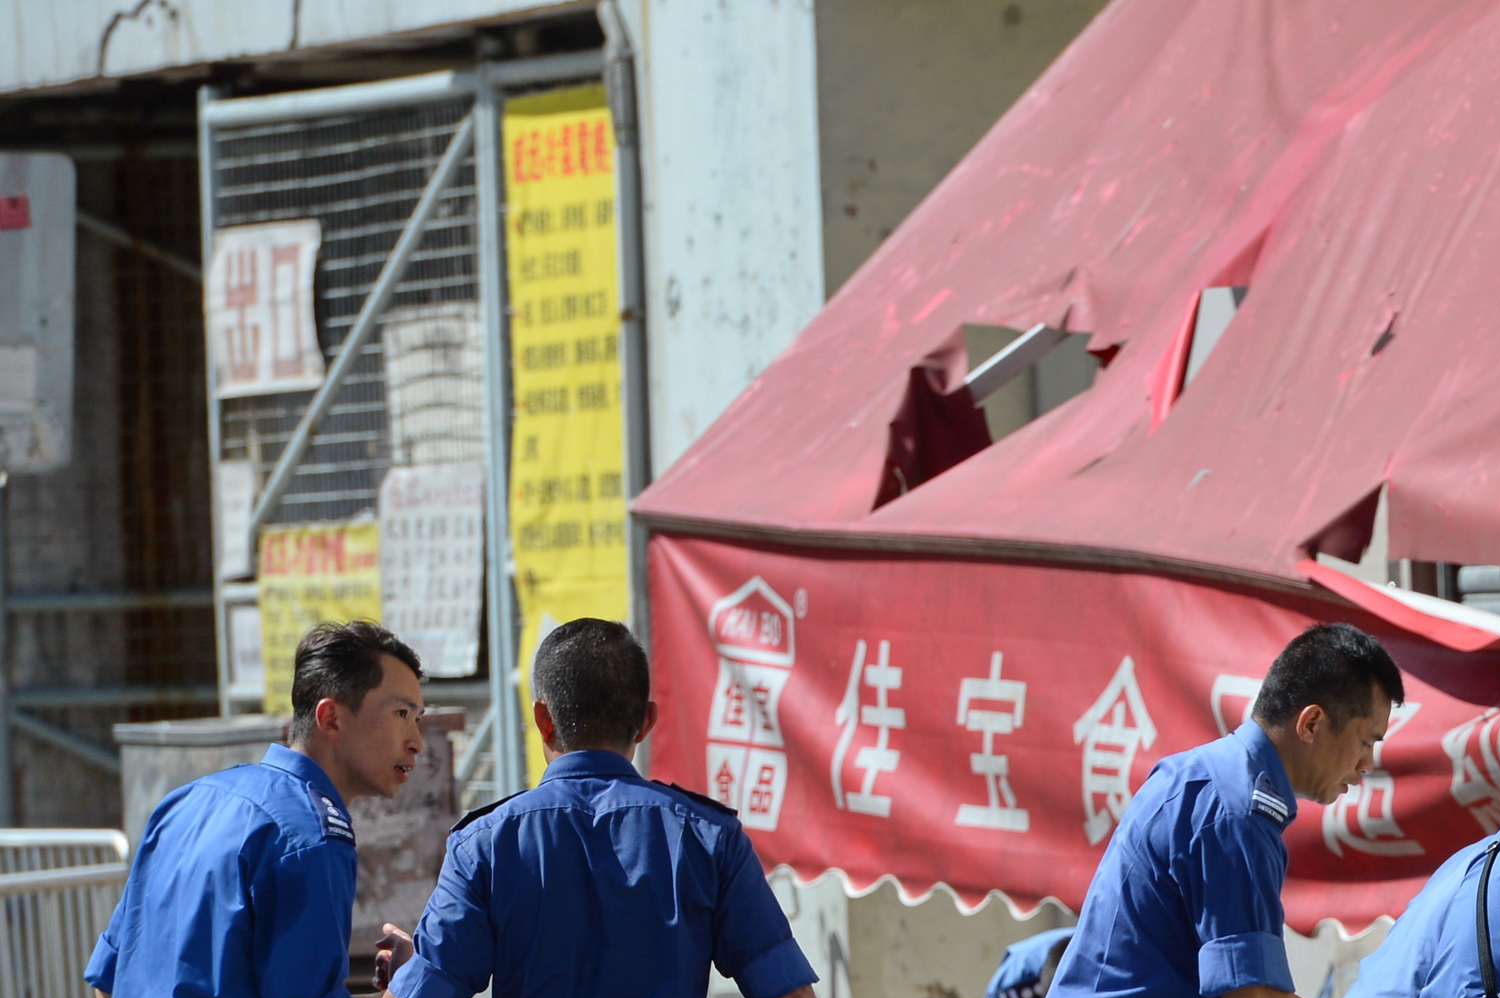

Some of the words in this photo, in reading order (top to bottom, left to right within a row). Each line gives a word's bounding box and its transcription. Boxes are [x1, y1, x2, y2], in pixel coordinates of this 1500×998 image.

[223, 245, 305, 382] 出口
[723, 608, 756, 639] KAI
[760, 612, 782, 646] BO
[715, 759, 776, 814] 食品
